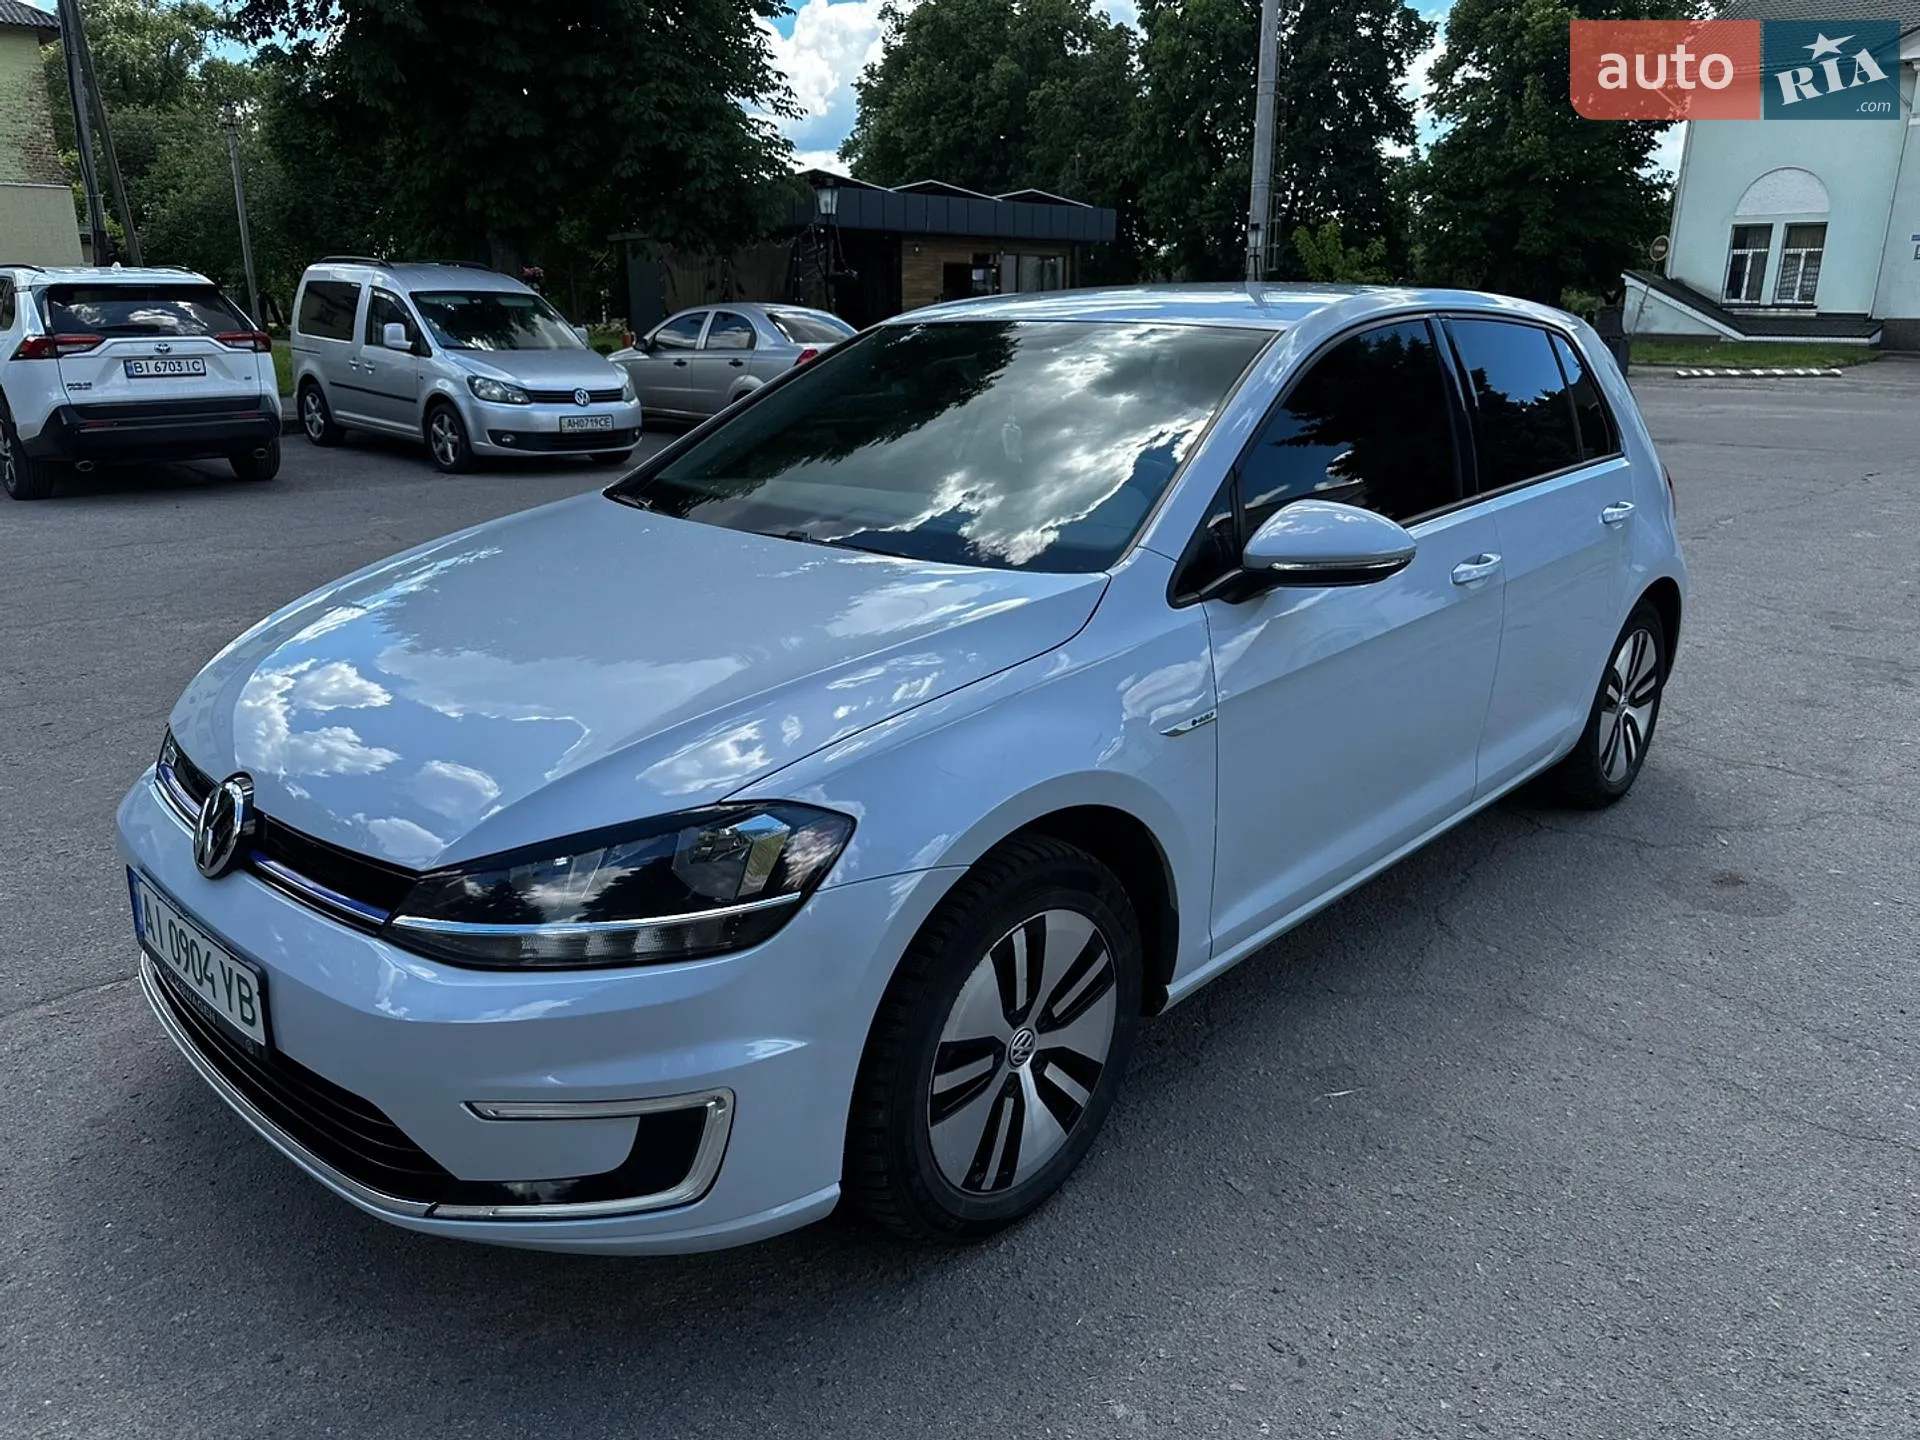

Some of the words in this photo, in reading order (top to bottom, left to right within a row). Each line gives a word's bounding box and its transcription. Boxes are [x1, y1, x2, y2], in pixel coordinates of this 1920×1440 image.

[133, 362, 149, 374] BI
[154, 361, 184, 373] 6703
[186, 360, 201, 372] IC
[143, 893, 164, 950] AI
[168, 918, 217, 999] 0904
[219, 959, 256, 1028] YB
